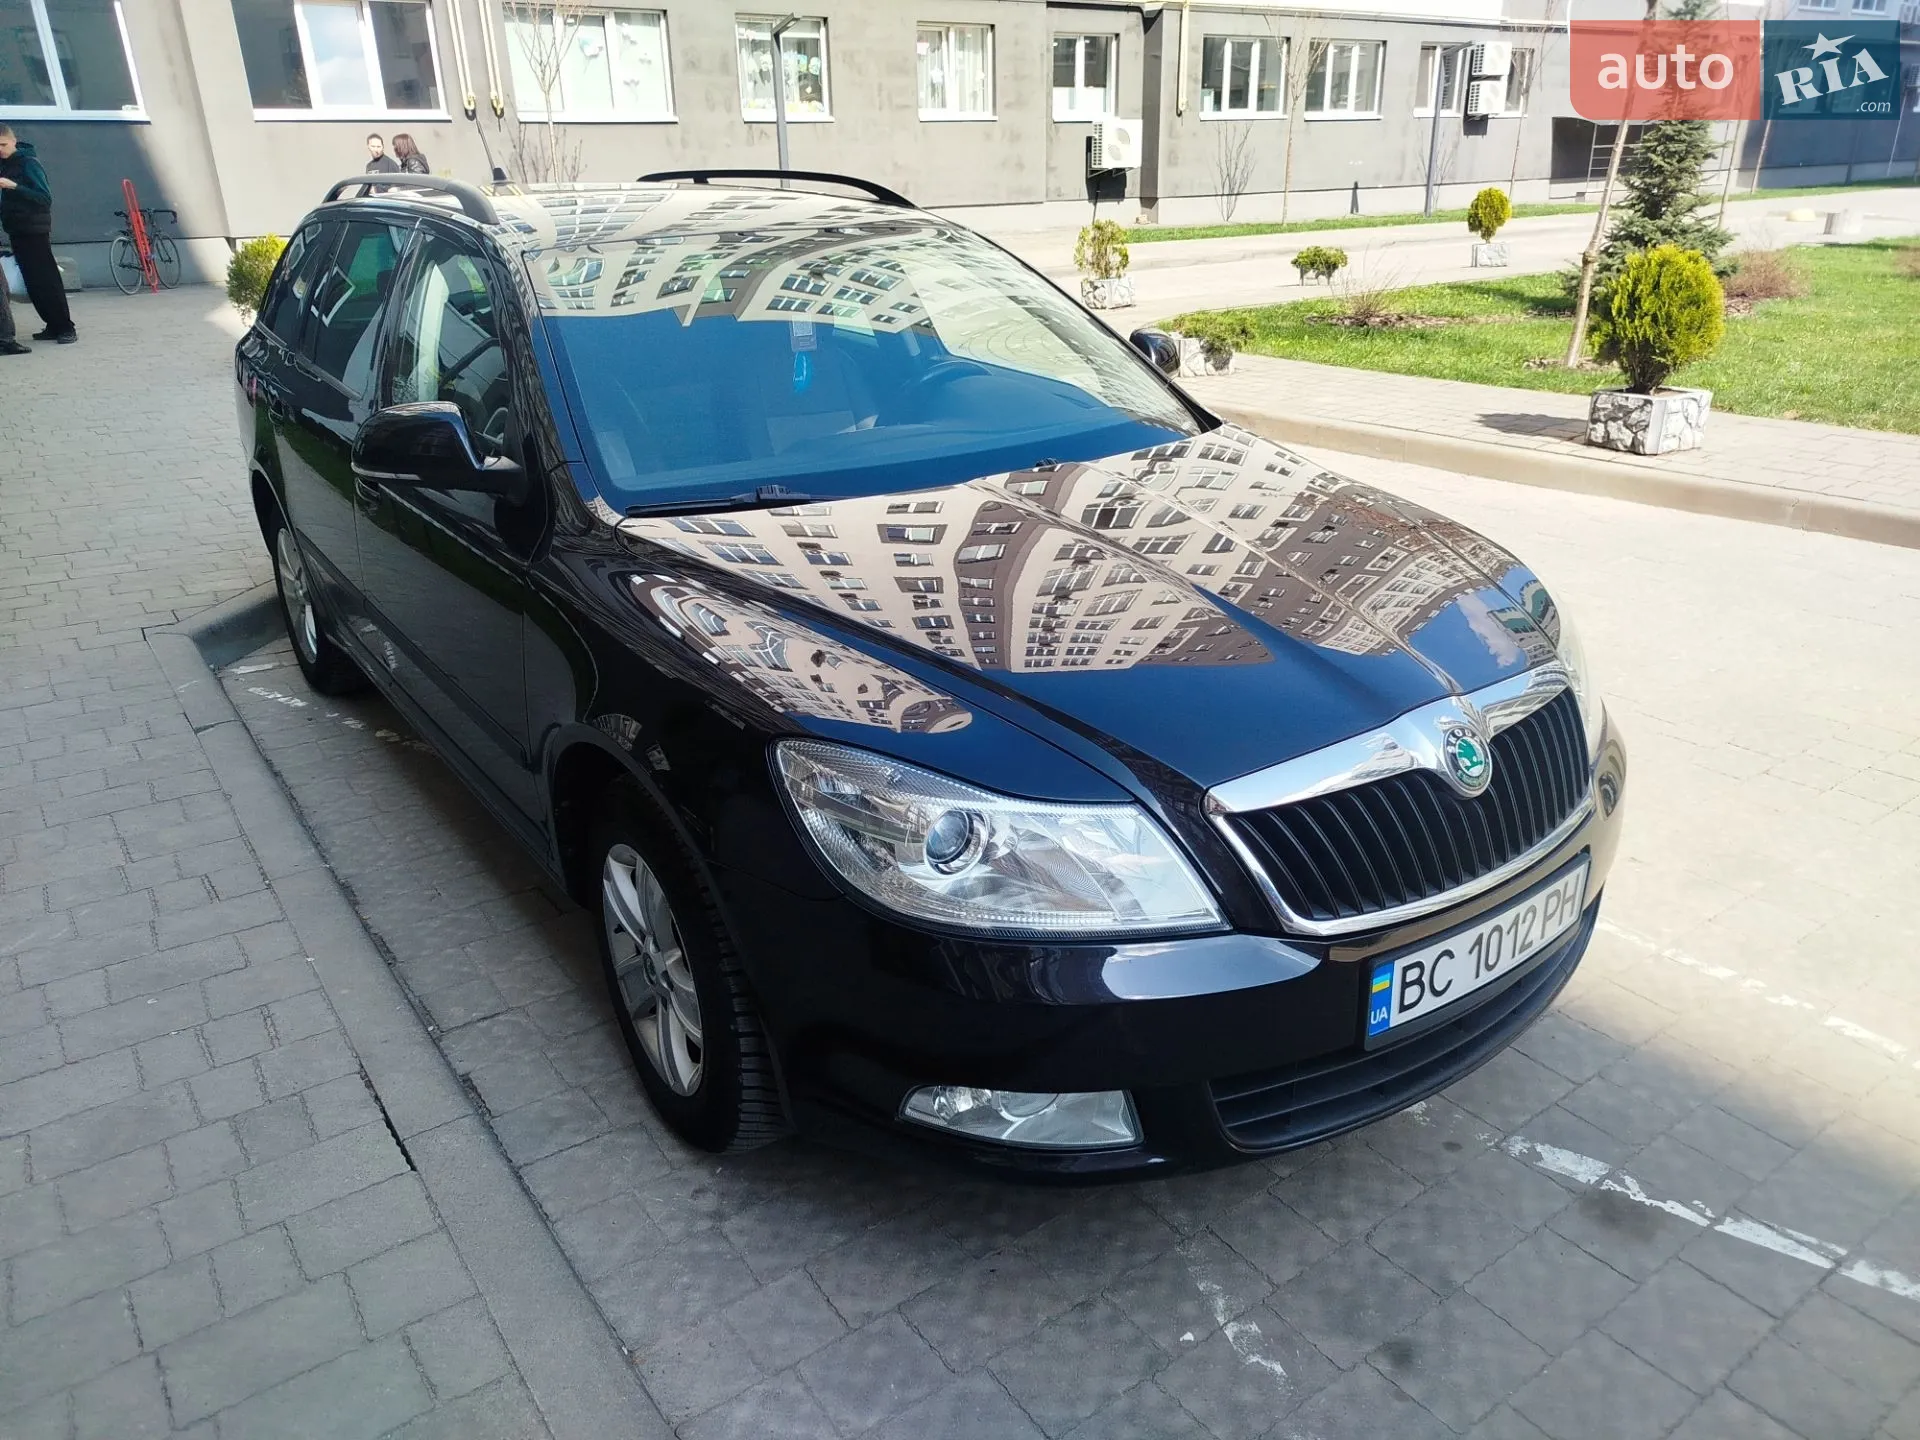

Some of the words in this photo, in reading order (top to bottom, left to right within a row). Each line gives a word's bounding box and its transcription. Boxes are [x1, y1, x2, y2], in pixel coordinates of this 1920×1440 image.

[1399, 949, 1455, 1013] BC
[1468, 904, 1537, 980] 1012
[1540, 873, 1581, 940] PH
[1371, 1006, 1388, 1024] UA
